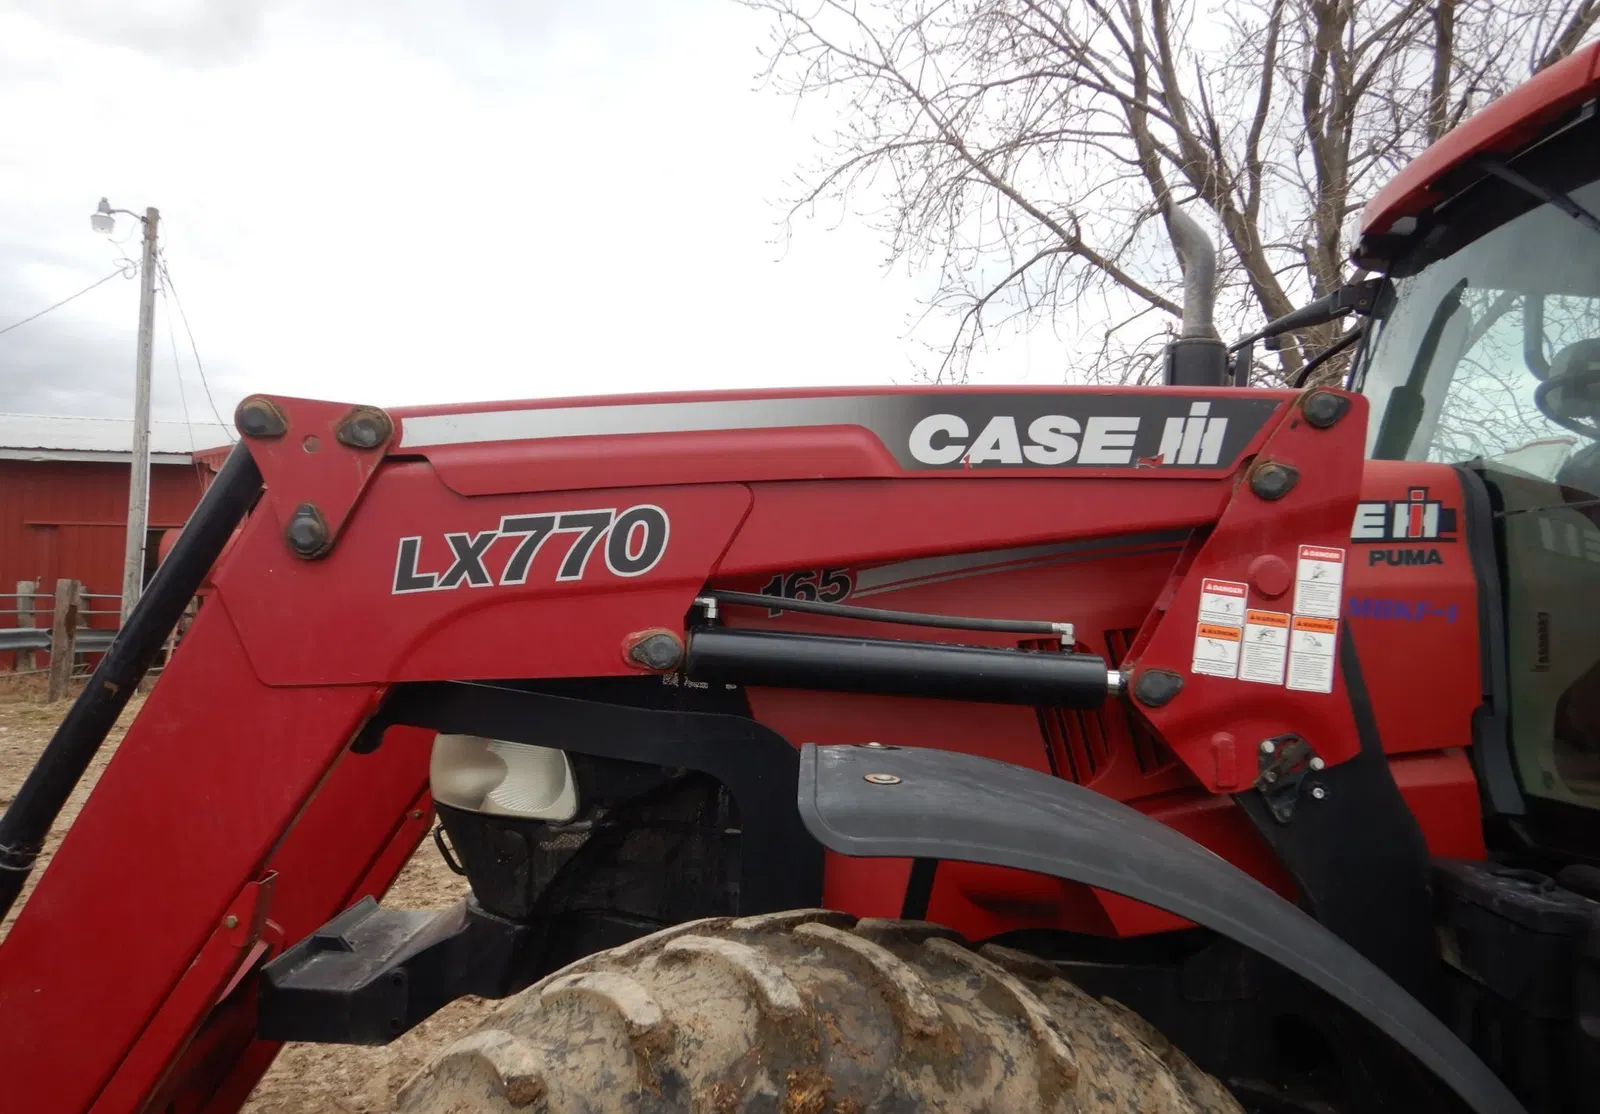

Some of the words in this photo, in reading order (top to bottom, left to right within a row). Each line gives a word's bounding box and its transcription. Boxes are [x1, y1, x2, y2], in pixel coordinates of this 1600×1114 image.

[909, 414, 1141, 465] CASE
[391, 504, 670, 594] LX770
[1309, 550, 1341, 559] DANGER
[1368, 549, 1443, 567] PUMA
[760, 568, 852, 618] 165
[1212, 585, 1244, 594] DANGER
[1256, 614, 1287, 624] WARNING
[1302, 621, 1334, 631] WARNING
[1207, 628, 1239, 638] WARNING
